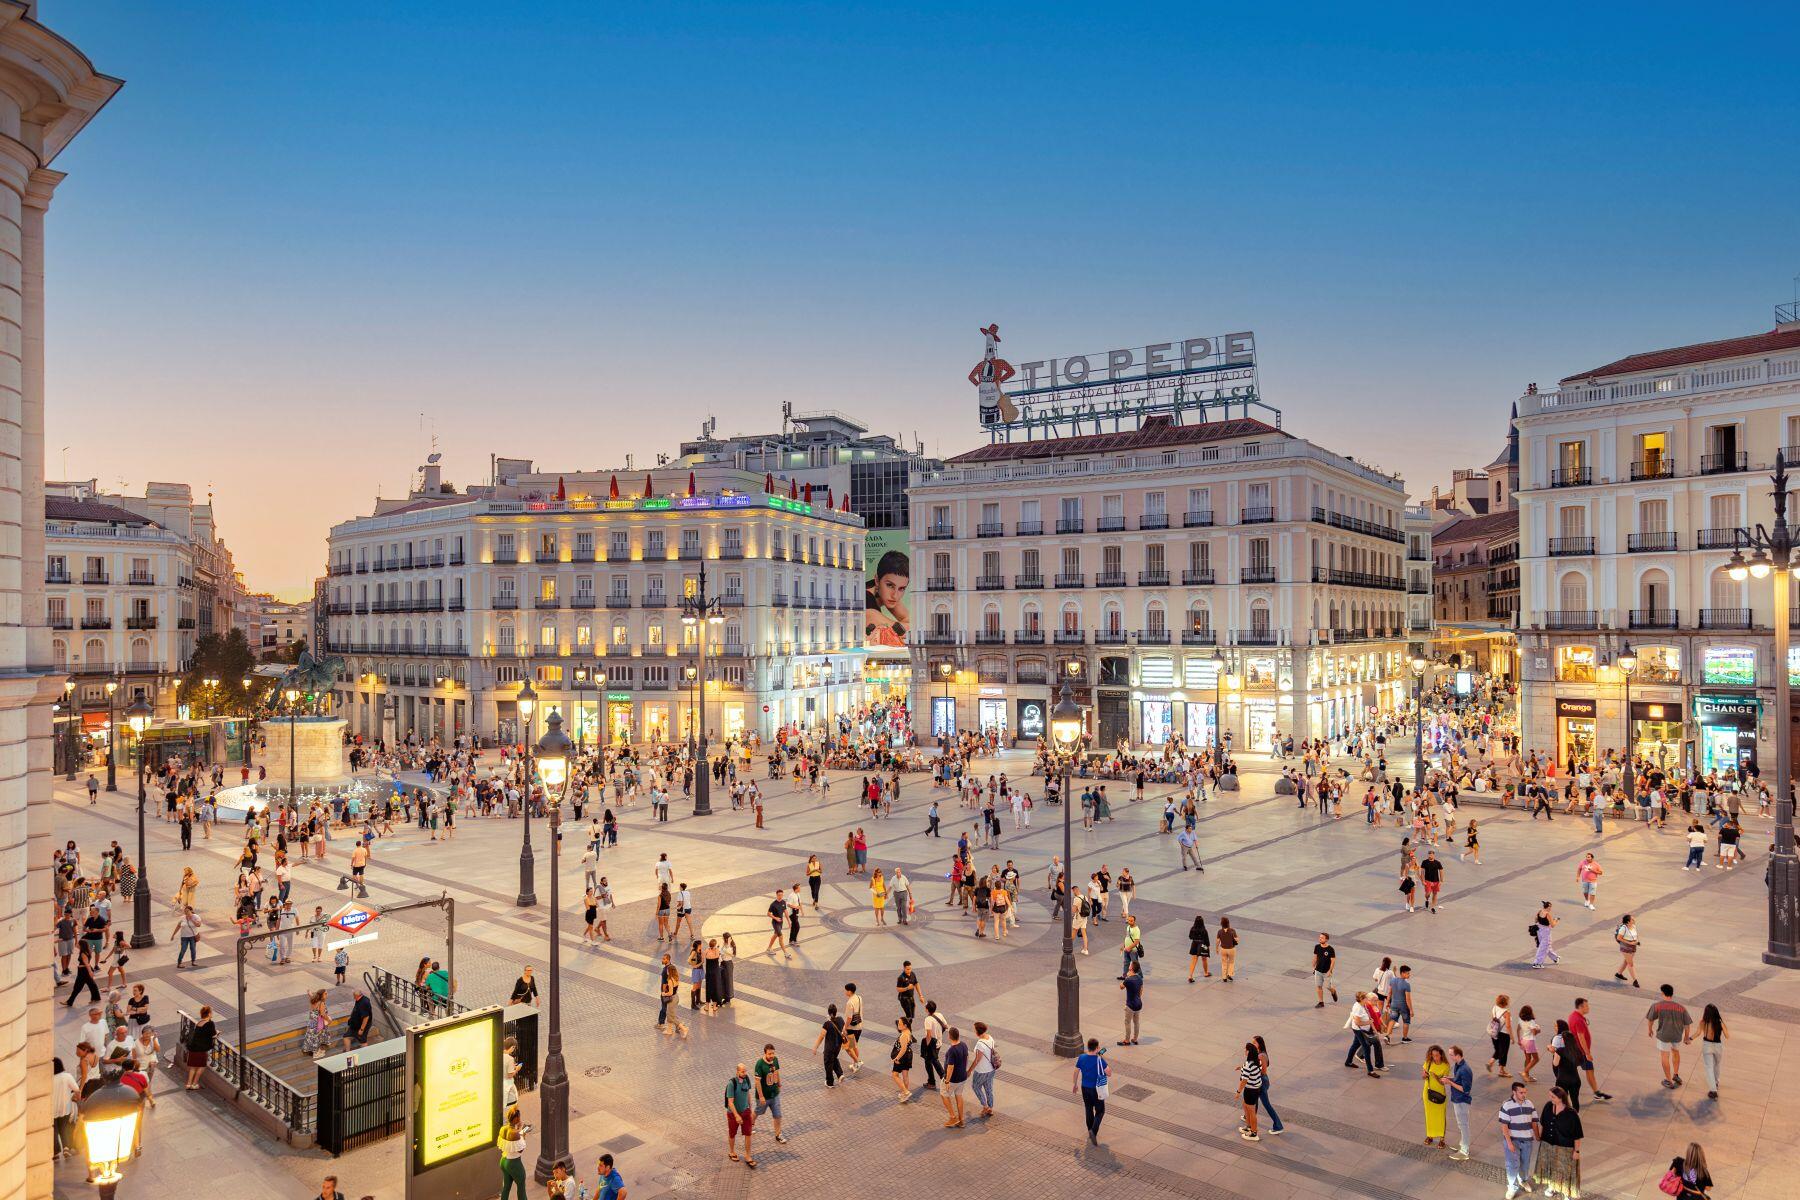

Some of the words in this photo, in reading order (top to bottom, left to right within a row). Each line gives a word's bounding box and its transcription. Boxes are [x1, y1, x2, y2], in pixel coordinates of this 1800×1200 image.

[1021, 355, 1090, 389] TIO
[1109, 331, 1253, 380] PEPE
[1022, 399, 1147, 428] GONZALEZ
[1560, 703, 1592, 712] Orange
[1703, 704, 1753, 714] CHANGE
[1738, 731, 1756, 739] ATM
[343, 913, 367, 926] Metro
